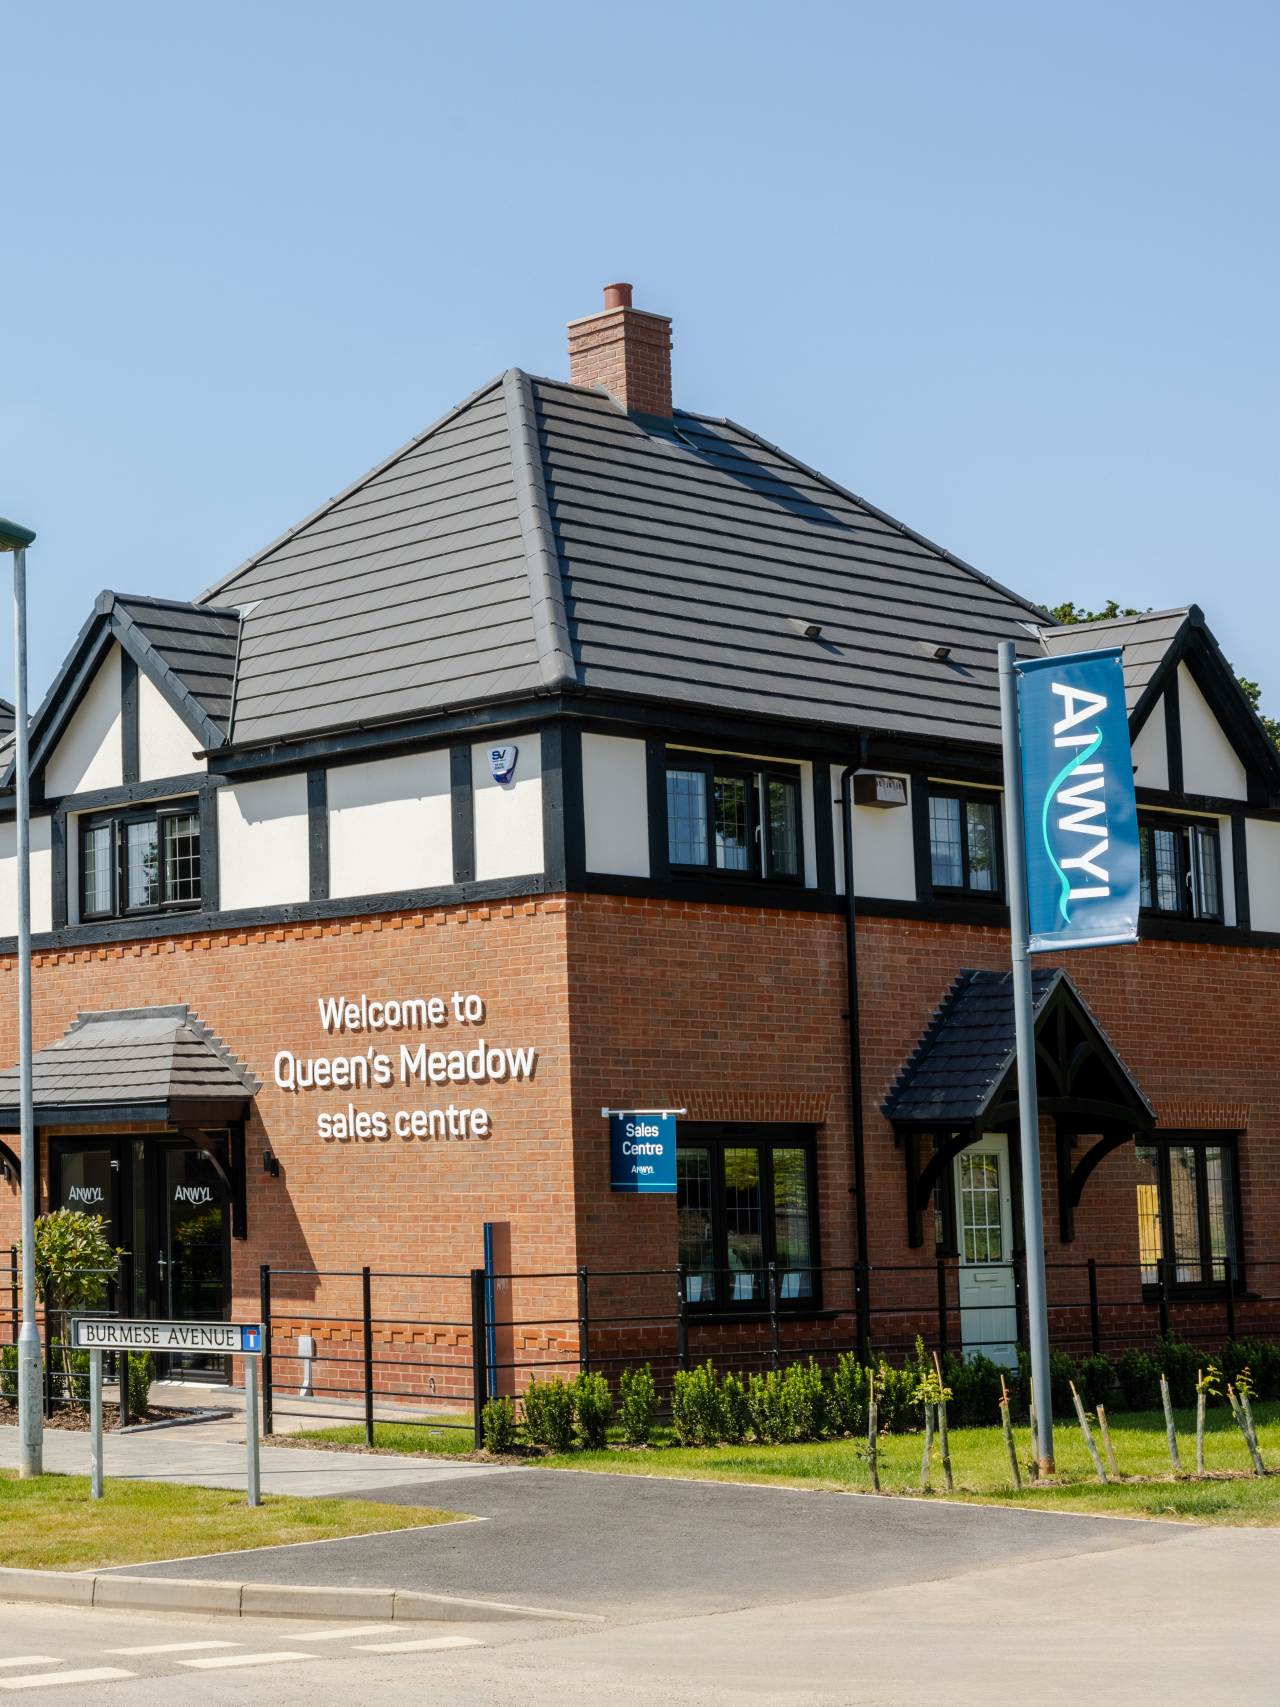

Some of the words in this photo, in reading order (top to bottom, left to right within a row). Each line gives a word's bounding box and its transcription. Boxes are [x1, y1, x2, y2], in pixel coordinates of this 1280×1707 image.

[1042, 682, 1110, 924] ANWYL
[318, 994, 445, 1029] Welcome
[451, 991, 482, 1022] to
[274, 1046, 391, 1090] Queen's
[400, 1039, 535, 1082] Meadow
[318, 1103, 387, 1138] sales
[395, 1104, 488, 1137] centre
[626, 1122, 659, 1137] Sales
[622, 1141, 663, 1155] Centre
[631, 1165, 655, 1175] ANWYL
[69, 1186, 104, 1204] ANWYL
[175, 1185, 213, 1204] ANWYL
[87, 1325, 160, 1344] BURMESE
[168, 1327, 234, 1346] AVENUE
